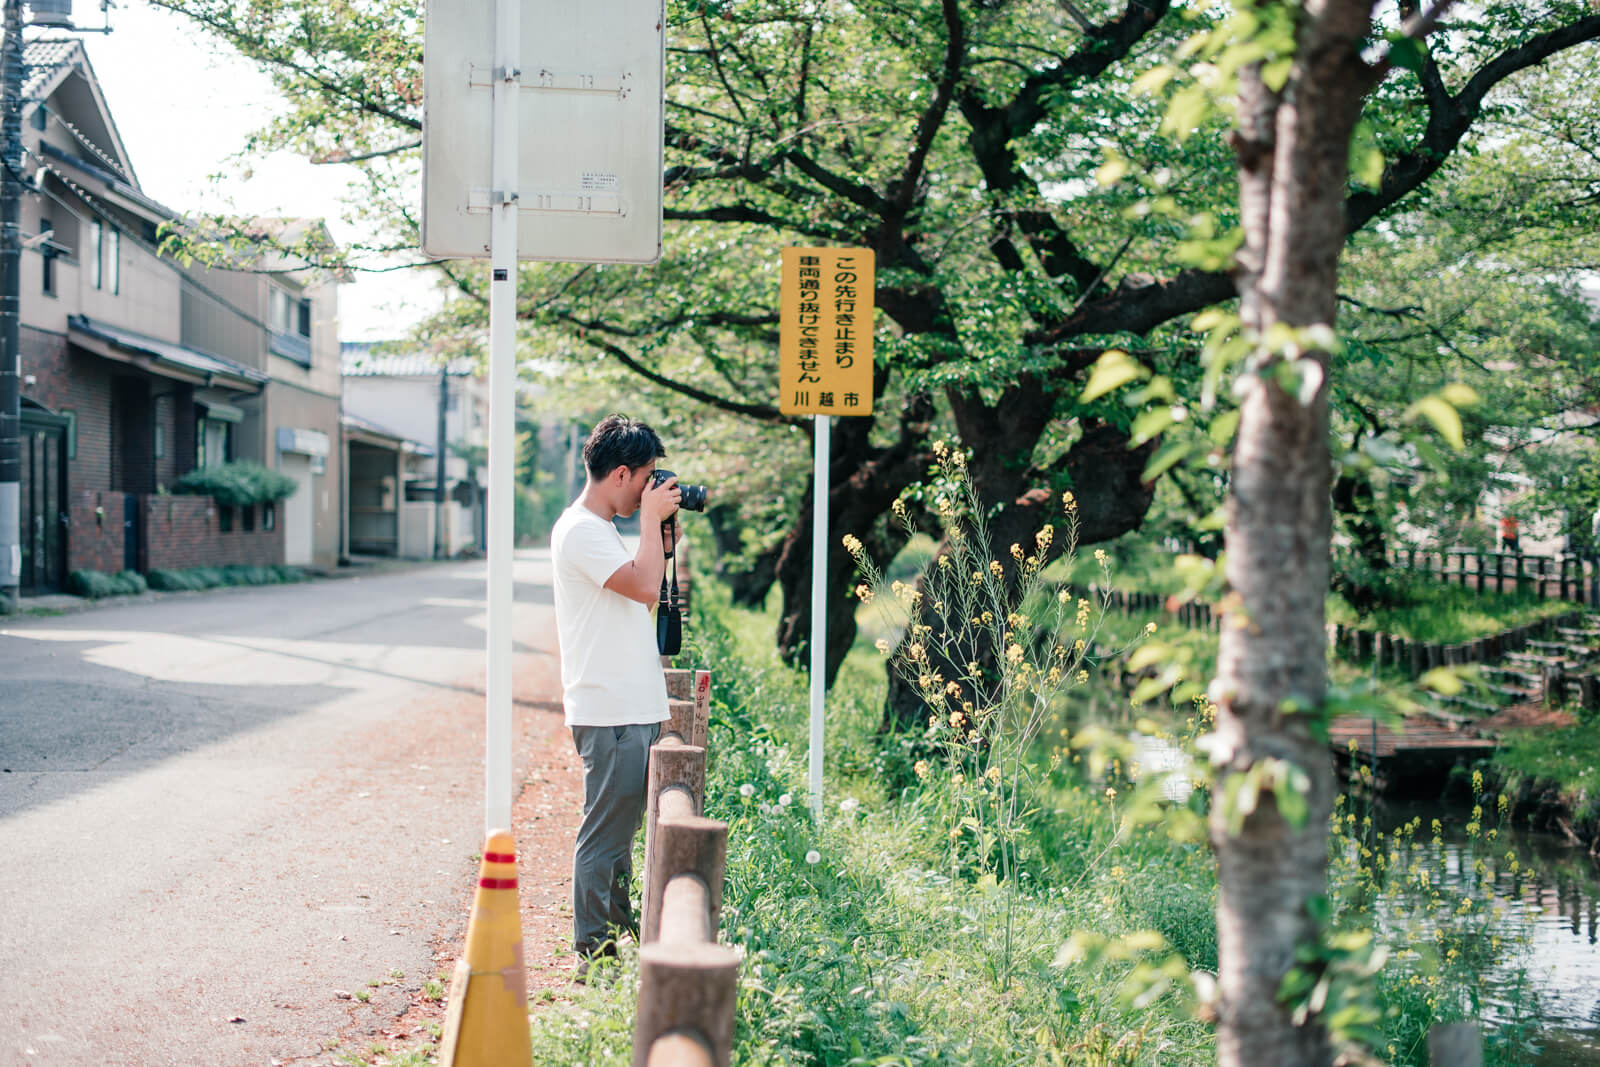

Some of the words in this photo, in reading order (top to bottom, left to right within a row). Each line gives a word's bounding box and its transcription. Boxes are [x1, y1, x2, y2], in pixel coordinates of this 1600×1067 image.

[797, 256, 821, 383] 車両通り抜けできません
[834, 257, 857, 369] この先行き止まり
[794, 391, 859, 407] 川越市
